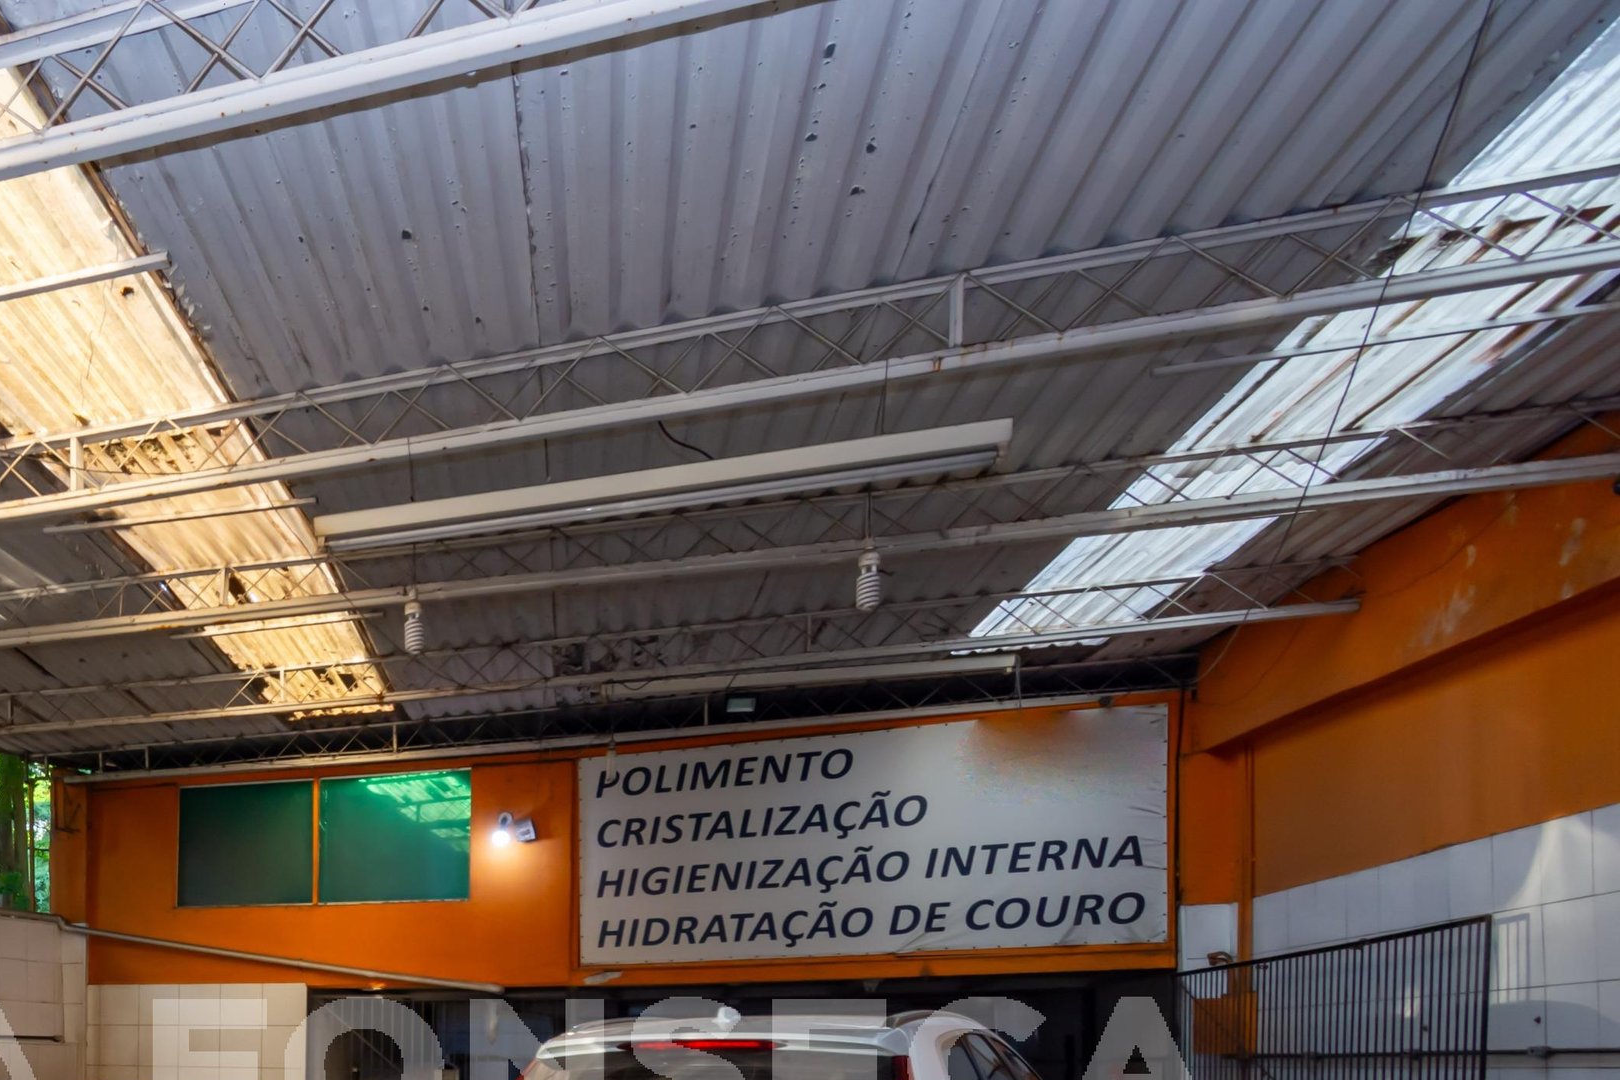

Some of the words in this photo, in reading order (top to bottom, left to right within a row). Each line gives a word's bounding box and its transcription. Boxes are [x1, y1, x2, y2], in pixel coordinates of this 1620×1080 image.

[596, 748, 853, 798] POLIMENTO
[597, 790, 927, 848] CRISTALIZAÇÃO
[597, 846, 909, 898] HIGIENIZAÇÃO
[925, 835, 1144, 878] INTERNA
[597, 901, 873, 948] HIDRATAÇÃO
[889, 902, 951, 936] DE
[965, 892, 1146, 931] COURO
